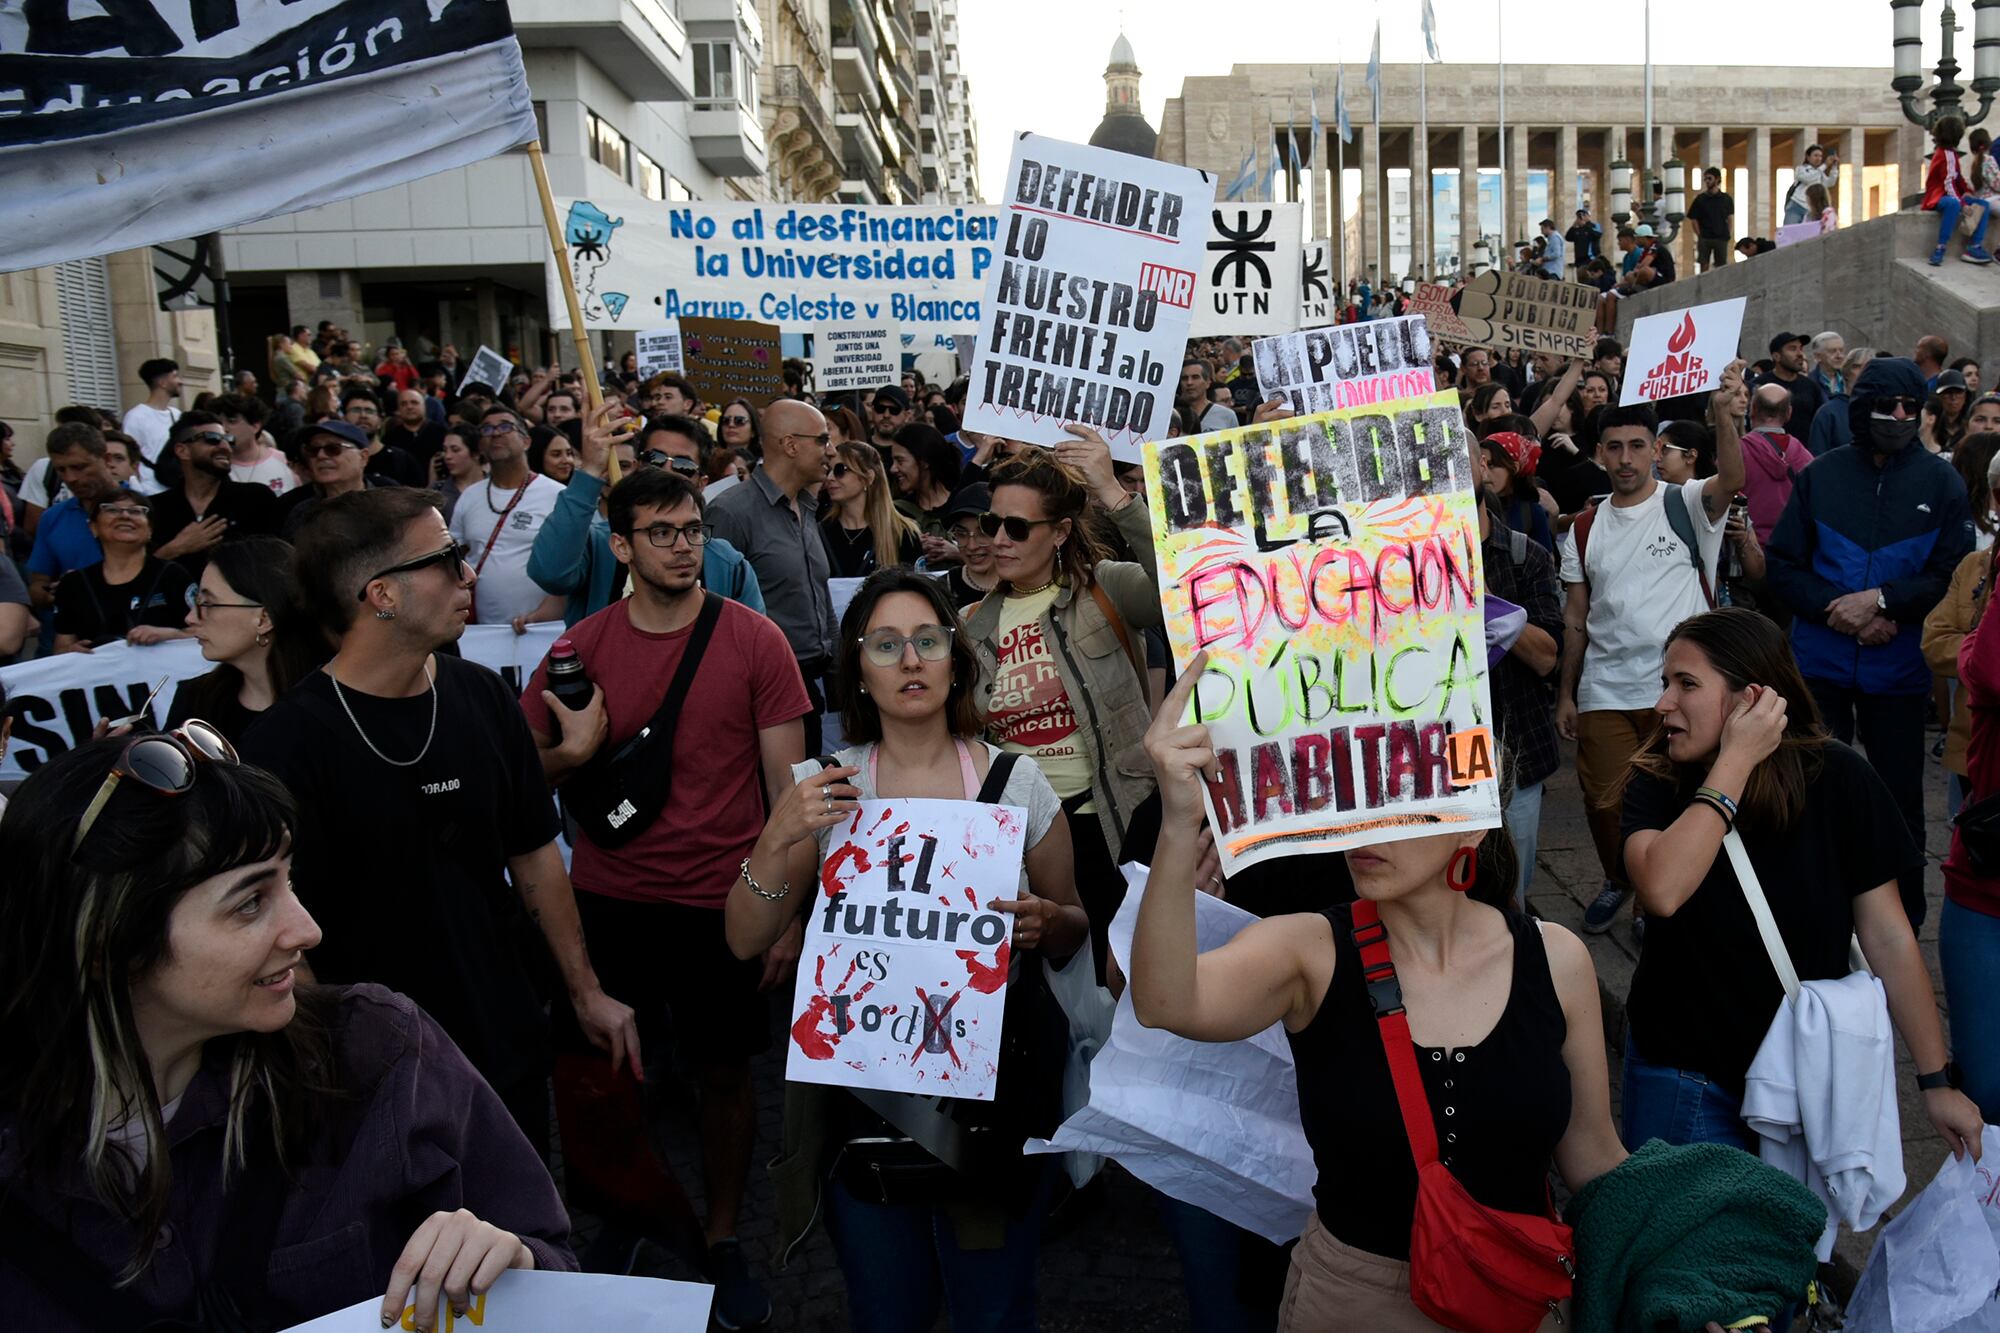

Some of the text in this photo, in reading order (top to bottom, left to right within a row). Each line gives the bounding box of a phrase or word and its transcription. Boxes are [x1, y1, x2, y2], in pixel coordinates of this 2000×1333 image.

[1016, 158, 1184, 238] DEFENDER
[669, 210, 716, 240] No
[731, 208, 764, 241] al
[1003, 213, 1049, 262] LO
[695, 246, 992, 280] la Universidad P
[996, 260, 1159, 334] NUESTRO
[1141, 265, 1191, 306] UNR
[759, 291, 855, 322] Celeste
[891, 293, 981, 322] Blanca
[1213, 291, 1270, 316] UTN
[1301, 302, 1326, 318] TN
[827, 329, 887, 341] CONSTRUYAMOS
[835, 341, 881, 352] JUNTOS UNA
[990, 310, 1116, 377] FRENTE
[1502, 324, 1587, 357] SIEMPRE
[823, 363, 894, 376] ABIERTA AL PUEBLO
[833, 352, 883, 364] UNIVERSIDAD
[1253, 318, 1433, 390] UN PUEBLO
[1648, 350, 1704, 379] UNR
[827, 375, 892, 388] LIBRE Y GRATUITA
[981, 358, 1155, 435] TREMENDO
[1157, 406, 1474, 535] DEFENDER
[1254, 509, 1352, 552] LA
[1646, 541, 1678, 558] FUTURE
[992, 668, 1028, 696] sin
[1188, 631, 1486, 737] PÚBLICA
[988, 685, 1036, 714] cer
[7, 682, 158, 775] SIN
[822, 889, 1007, 947] futuro
[855, 946, 891, 982] es
